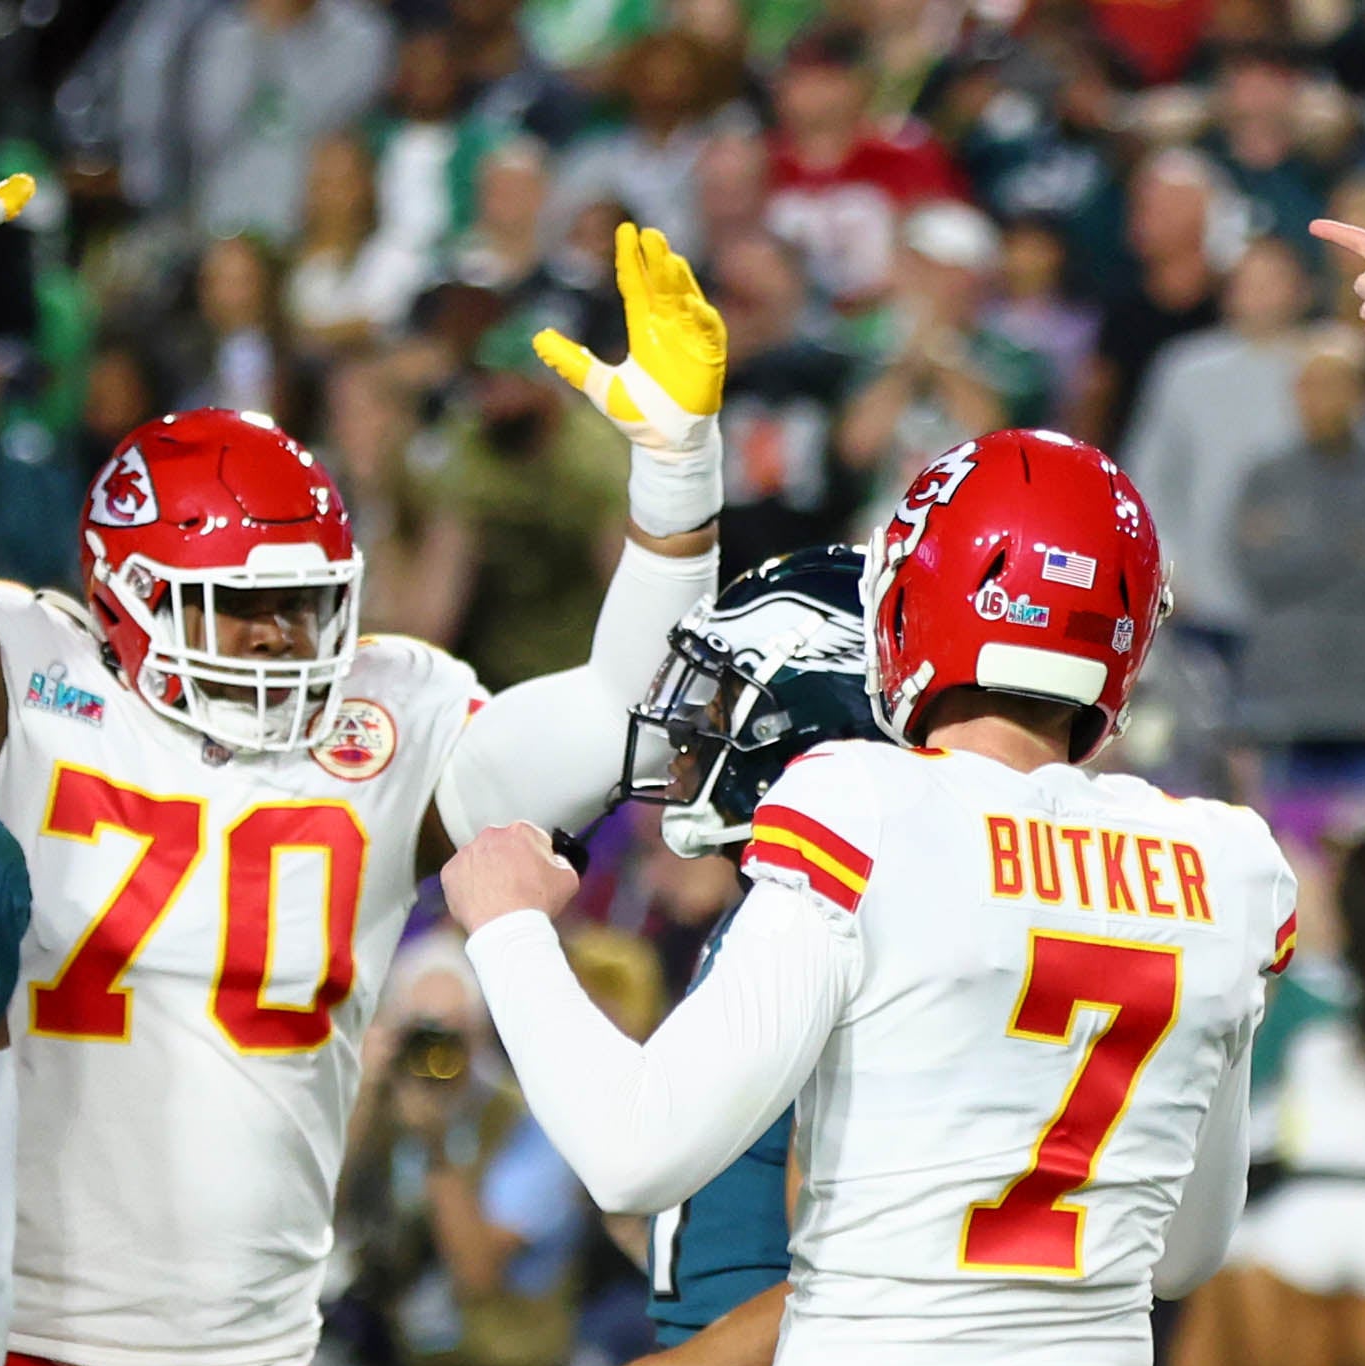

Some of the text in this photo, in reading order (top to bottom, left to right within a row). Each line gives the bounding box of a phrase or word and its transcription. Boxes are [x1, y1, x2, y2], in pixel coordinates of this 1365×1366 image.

[980, 590, 1004, 616] 16
[28, 760, 370, 1057] 70
[984, 813, 1215, 924] BUTKER
[957, 928, 1184, 1279] 7
